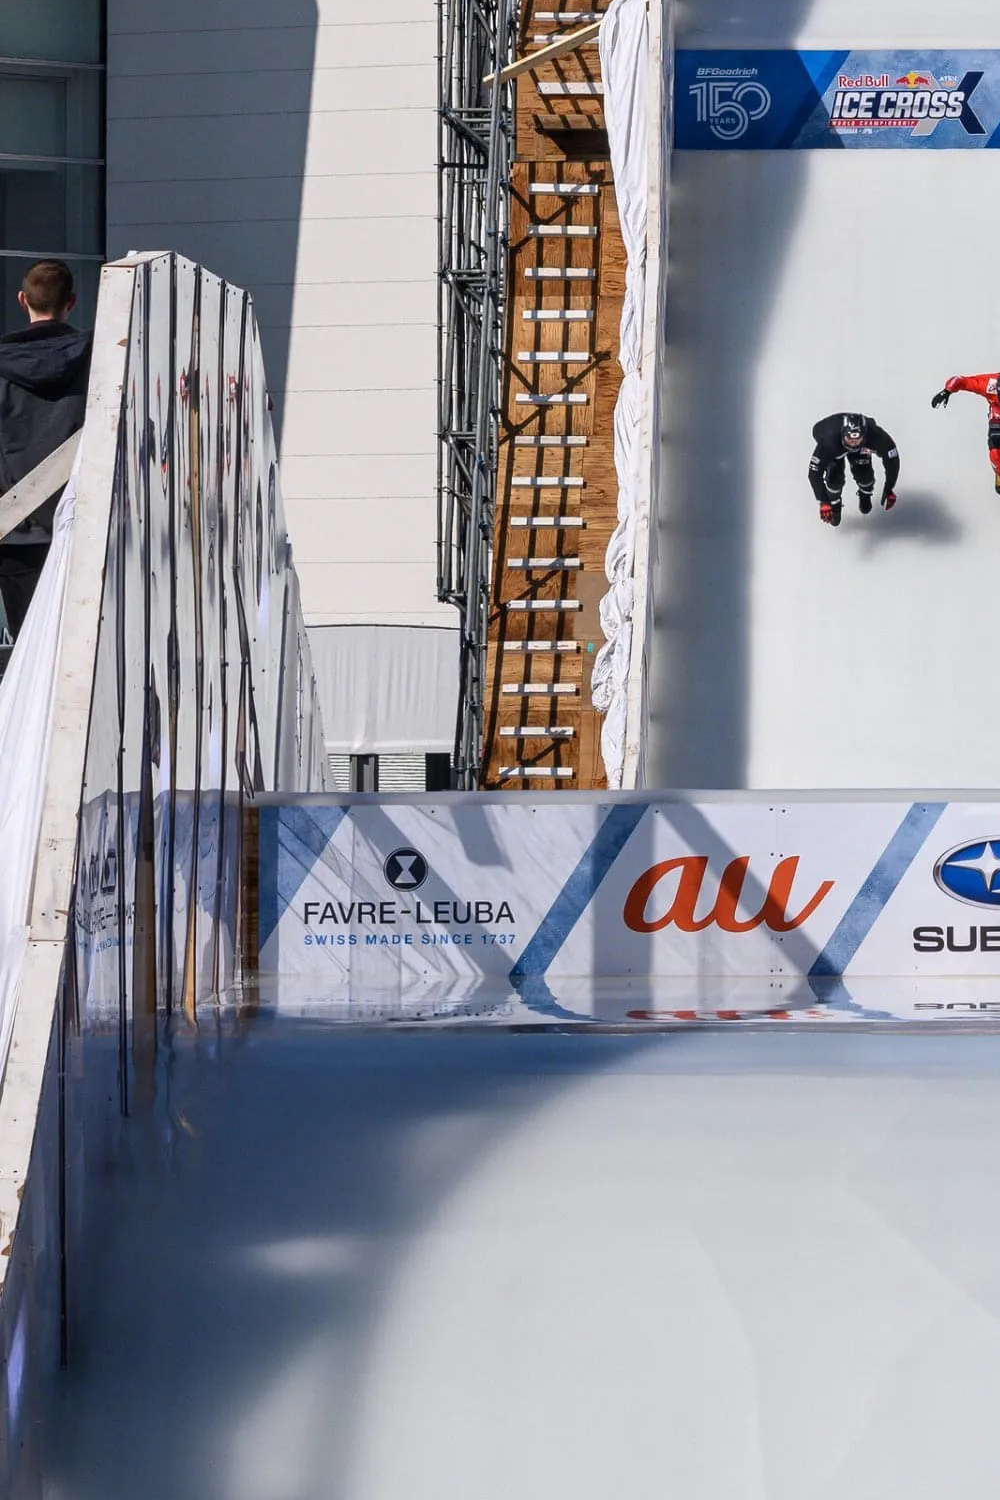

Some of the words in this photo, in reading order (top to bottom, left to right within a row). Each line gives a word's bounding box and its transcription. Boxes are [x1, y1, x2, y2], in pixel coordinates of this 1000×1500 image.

[697, 67, 758, 75] BFGoodrich
[838, 76, 863, 87] Red
[865, 75, 888, 87] Bull
[689, 82, 771, 140] 150
[833, 92, 876, 118] ICE
[878, 92, 965, 118] CROSS
[623, 855, 835, 933] au
[303, 901, 515, 925] FAVRE-LEUBA
[304, 934, 357, 946] SWISS
[365, 934, 413, 946] MADE
[421, 934, 473, 946] SINCE
[481, 934, 516, 946] 1737
